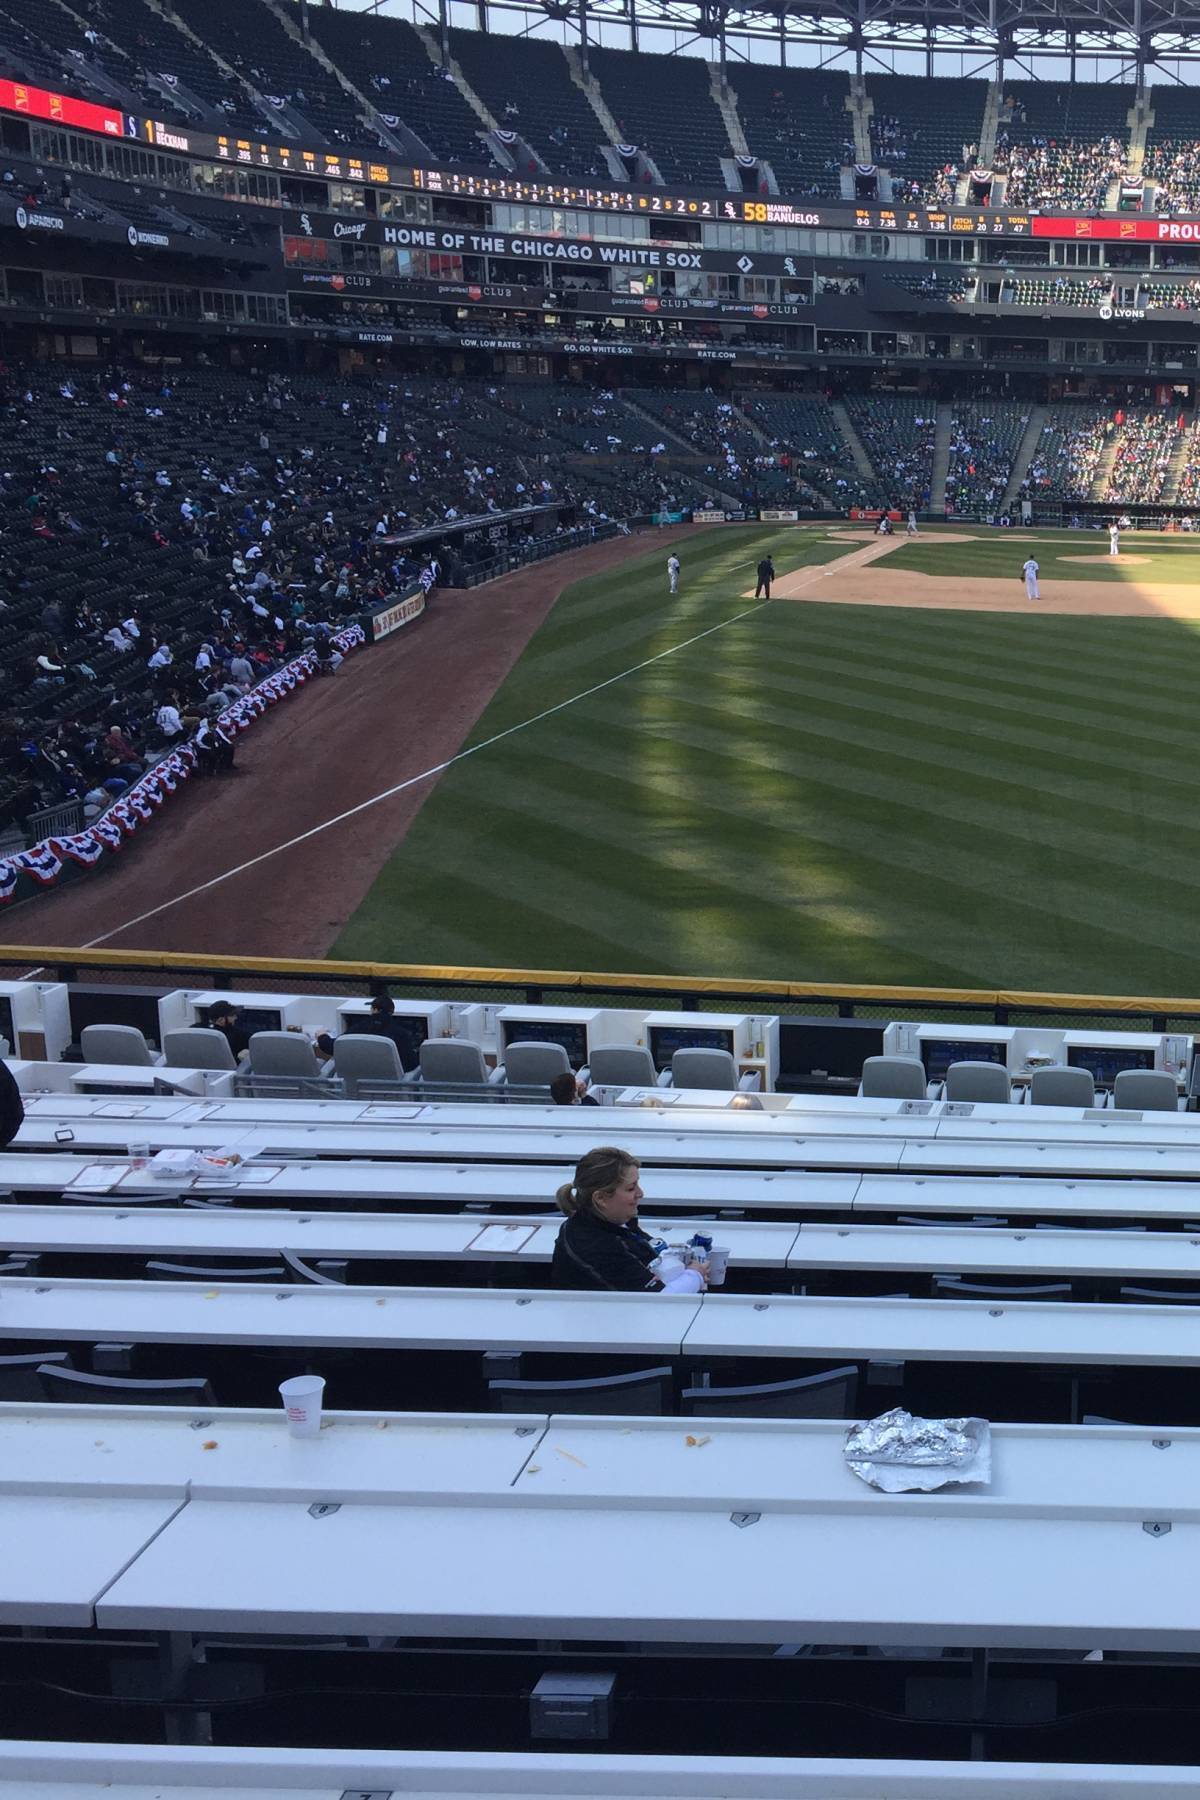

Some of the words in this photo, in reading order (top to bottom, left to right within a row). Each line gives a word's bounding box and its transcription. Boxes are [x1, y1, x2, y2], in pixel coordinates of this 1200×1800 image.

[145, 120, 153, 143] 1
[156, 131, 188, 150] BECKHAM
[282, 158, 288, 167] 4
[305, 162, 315, 171] 11
[428, 171, 441, 180] SEA
[652, 198, 661, 210] 2
[664, 200, 671, 210] S
[677, 200, 686, 212] 2
[702, 202, 711, 214] 2
[767, 204, 793, 213] MANNY
[743, 202, 767, 222] 58
[767, 211, 820, 225] BANUELOS
[953, 217, 973, 225] PITCH
[1008, 217, 1028, 225] TOTAL
[857, 218, 870, 226] 0-0
[907, 220, 919, 229] 3.2
[977, 223, 987, 231] 20
[993, 224, 1003, 232] 27
[1014, 224, 1023, 232] 47
[334, 222, 367, 240] Chicago
[384, 228, 436, 246] HOME
[441, 233, 465, 249] OF
[470, 236, 505, 252] THE
[511, 239, 593, 260] CHICAGO
[599, 247, 660, 265] WHITE
[666, 252, 702, 268] SOX
[346, 277, 371, 287] CLUB
[483, 288, 512, 297] CLUB
[660, 299, 688, 308] CLUB
[769, 305, 798, 314] CLUB
[1114, 309, 1145, 318] LYONS
[359, 333, 393, 343] RATE.COM
[461, 339, 479, 348] LOW,
[480, 339, 496, 347] LOW
[497, 340, 522, 349] RATES
[564, 344, 578, 354] GO,
[579, 345, 591, 353] GO
[592, 345, 617, 354] WHITE
[617, 346, 633, 354] SOX
[697, 351, 736, 359] RATE.COM
[741, 1514, 752, 1523] 7
[1152, 1524, 1161, 1532] 6
